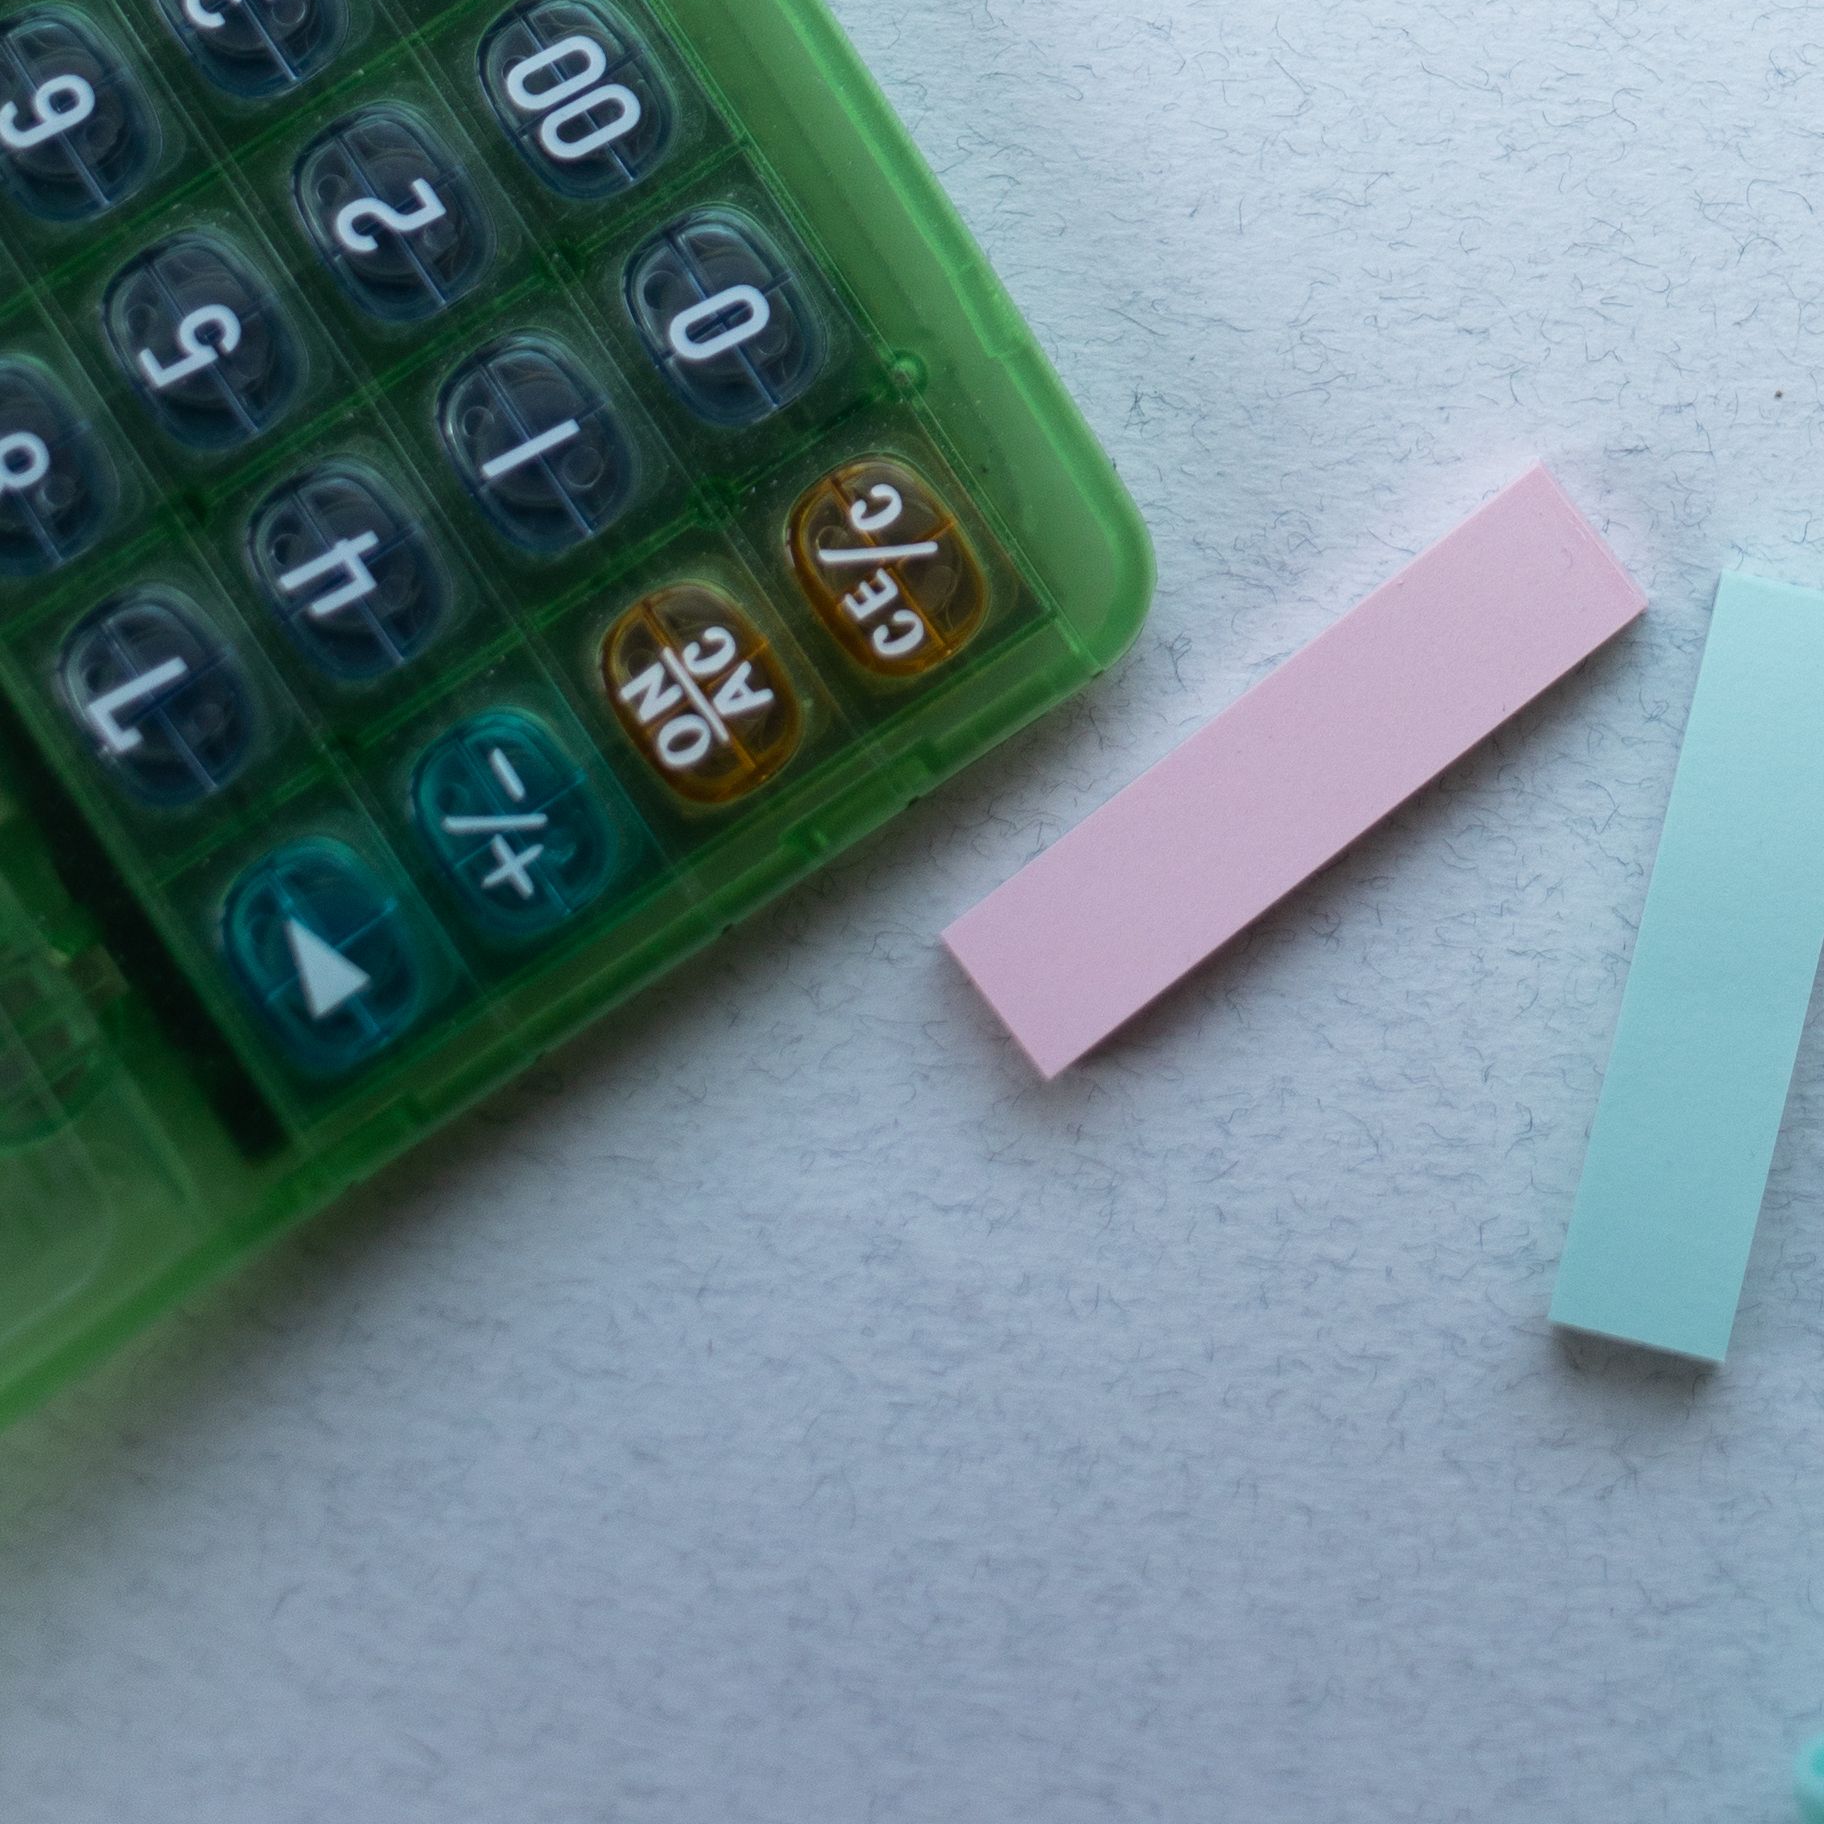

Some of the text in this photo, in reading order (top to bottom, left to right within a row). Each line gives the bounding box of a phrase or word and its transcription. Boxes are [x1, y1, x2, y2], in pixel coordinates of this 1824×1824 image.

[0, 75, 94, 148] 6
[505, 35, 640, 159] 00
[336, 178, 446, 252] 2
[139, 305, 240, 387] 5
[668, 285, 770, 360] 0
[482, 420, 579, 478] 1
[280, 531, 378, 616] 4
[87, 657, 187, 752] 7
[682, 626, 773, 716] AC
[619, 662, 711, 767] ON
